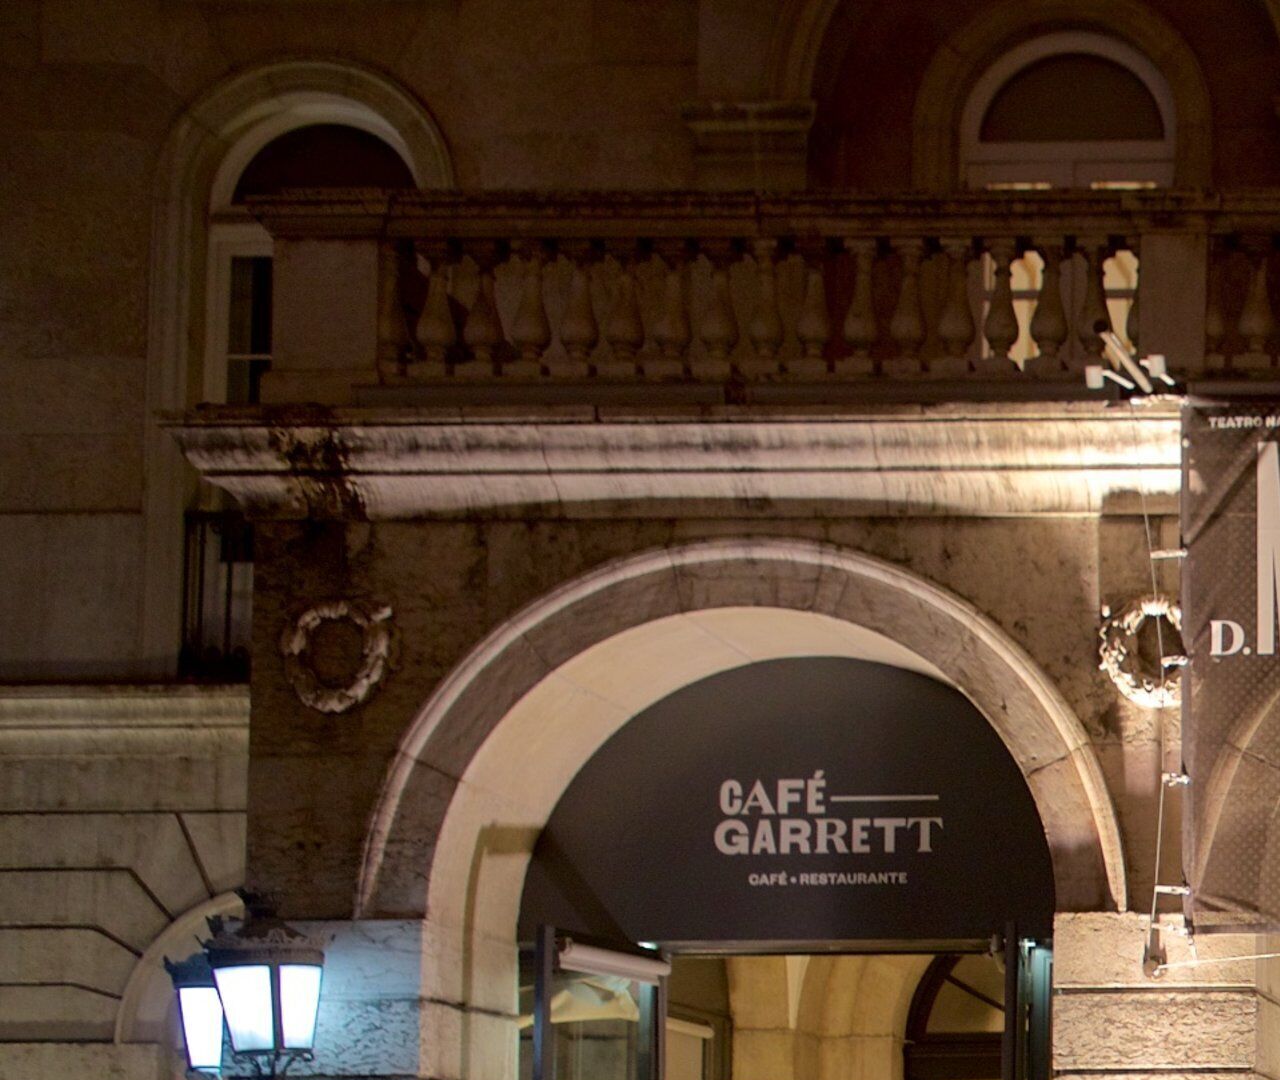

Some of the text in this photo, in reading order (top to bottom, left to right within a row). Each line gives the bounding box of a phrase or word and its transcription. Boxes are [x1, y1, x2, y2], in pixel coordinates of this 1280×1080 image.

[1208, 416, 1262, 429] TEATRO
[1210, 619, 1251, 655] D.
[719, 770, 827, 816] CAFÉ
[713, 816, 945, 856] GARRETT
[748, 870, 908, 886] CAFÉ RESTAURANTE
